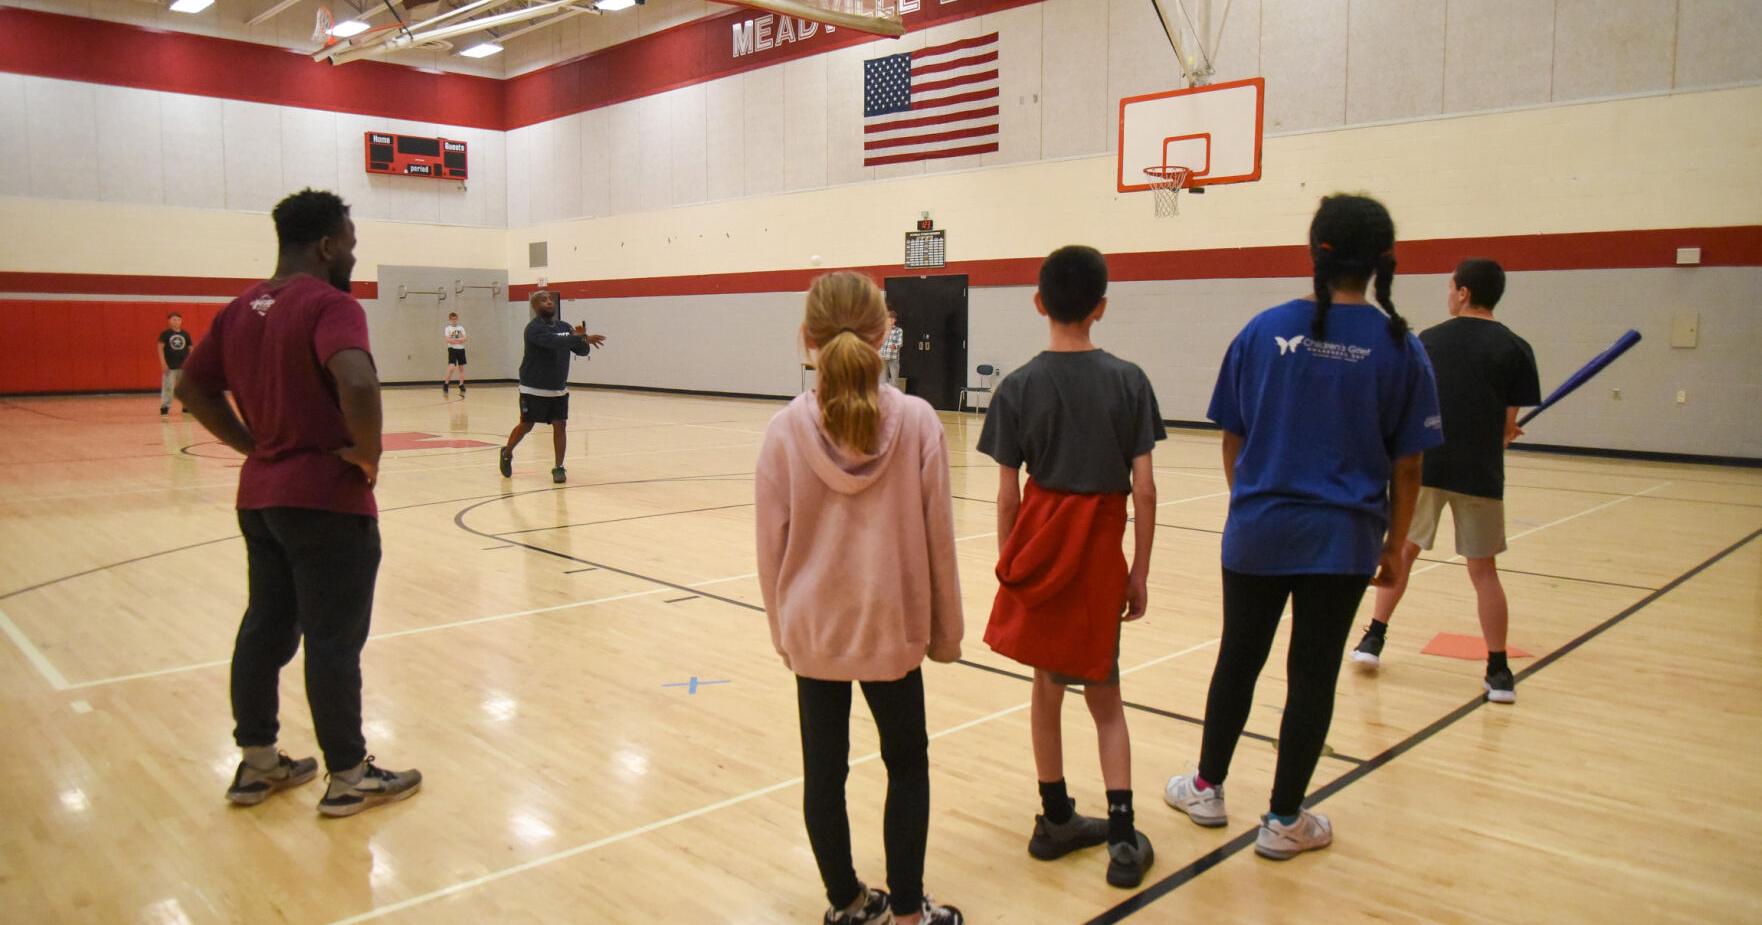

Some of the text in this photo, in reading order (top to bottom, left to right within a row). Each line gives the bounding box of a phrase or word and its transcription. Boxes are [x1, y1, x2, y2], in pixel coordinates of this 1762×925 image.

[373, 134, 391, 144] Home
[444, 142, 465, 152] Guests
[410, 165, 429, 174] period
